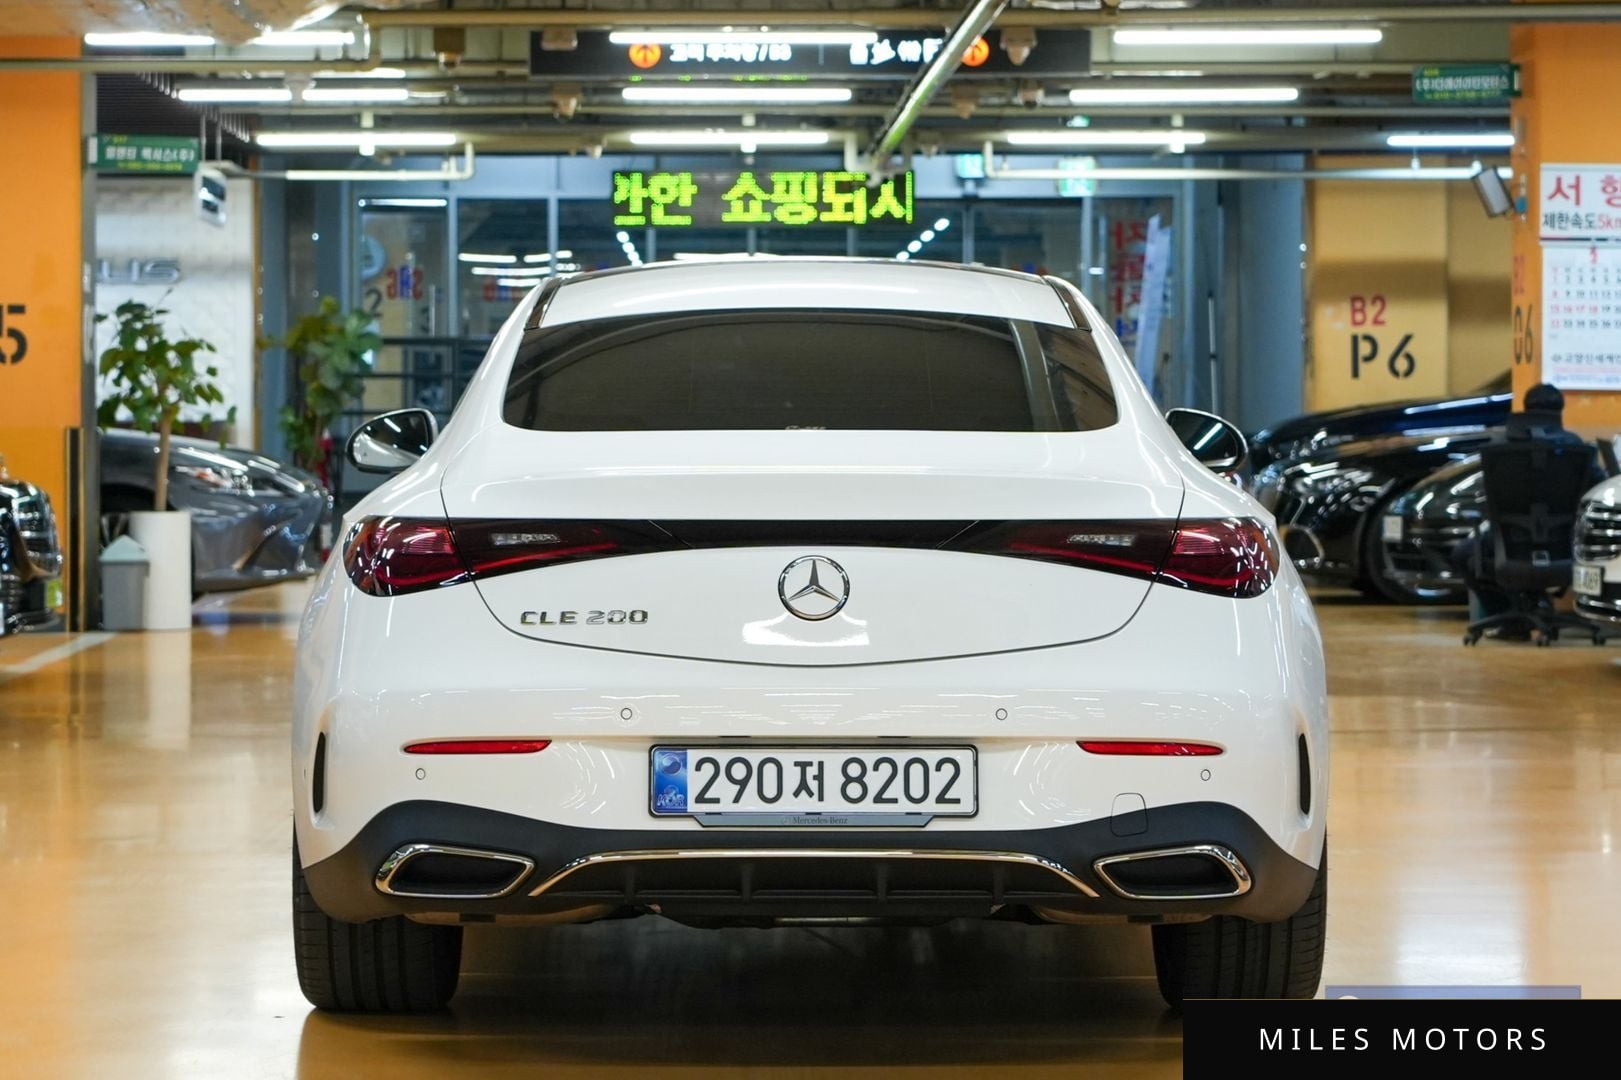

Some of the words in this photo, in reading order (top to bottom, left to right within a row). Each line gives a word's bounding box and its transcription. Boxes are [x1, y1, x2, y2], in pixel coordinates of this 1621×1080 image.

[1350, 294, 1387, 327] B2
[520, 611, 579, 625] CLE
[585, 609, 648, 625] 200
[694, 757, 824, 804] 290저
[840, 757, 961, 804] 8202
